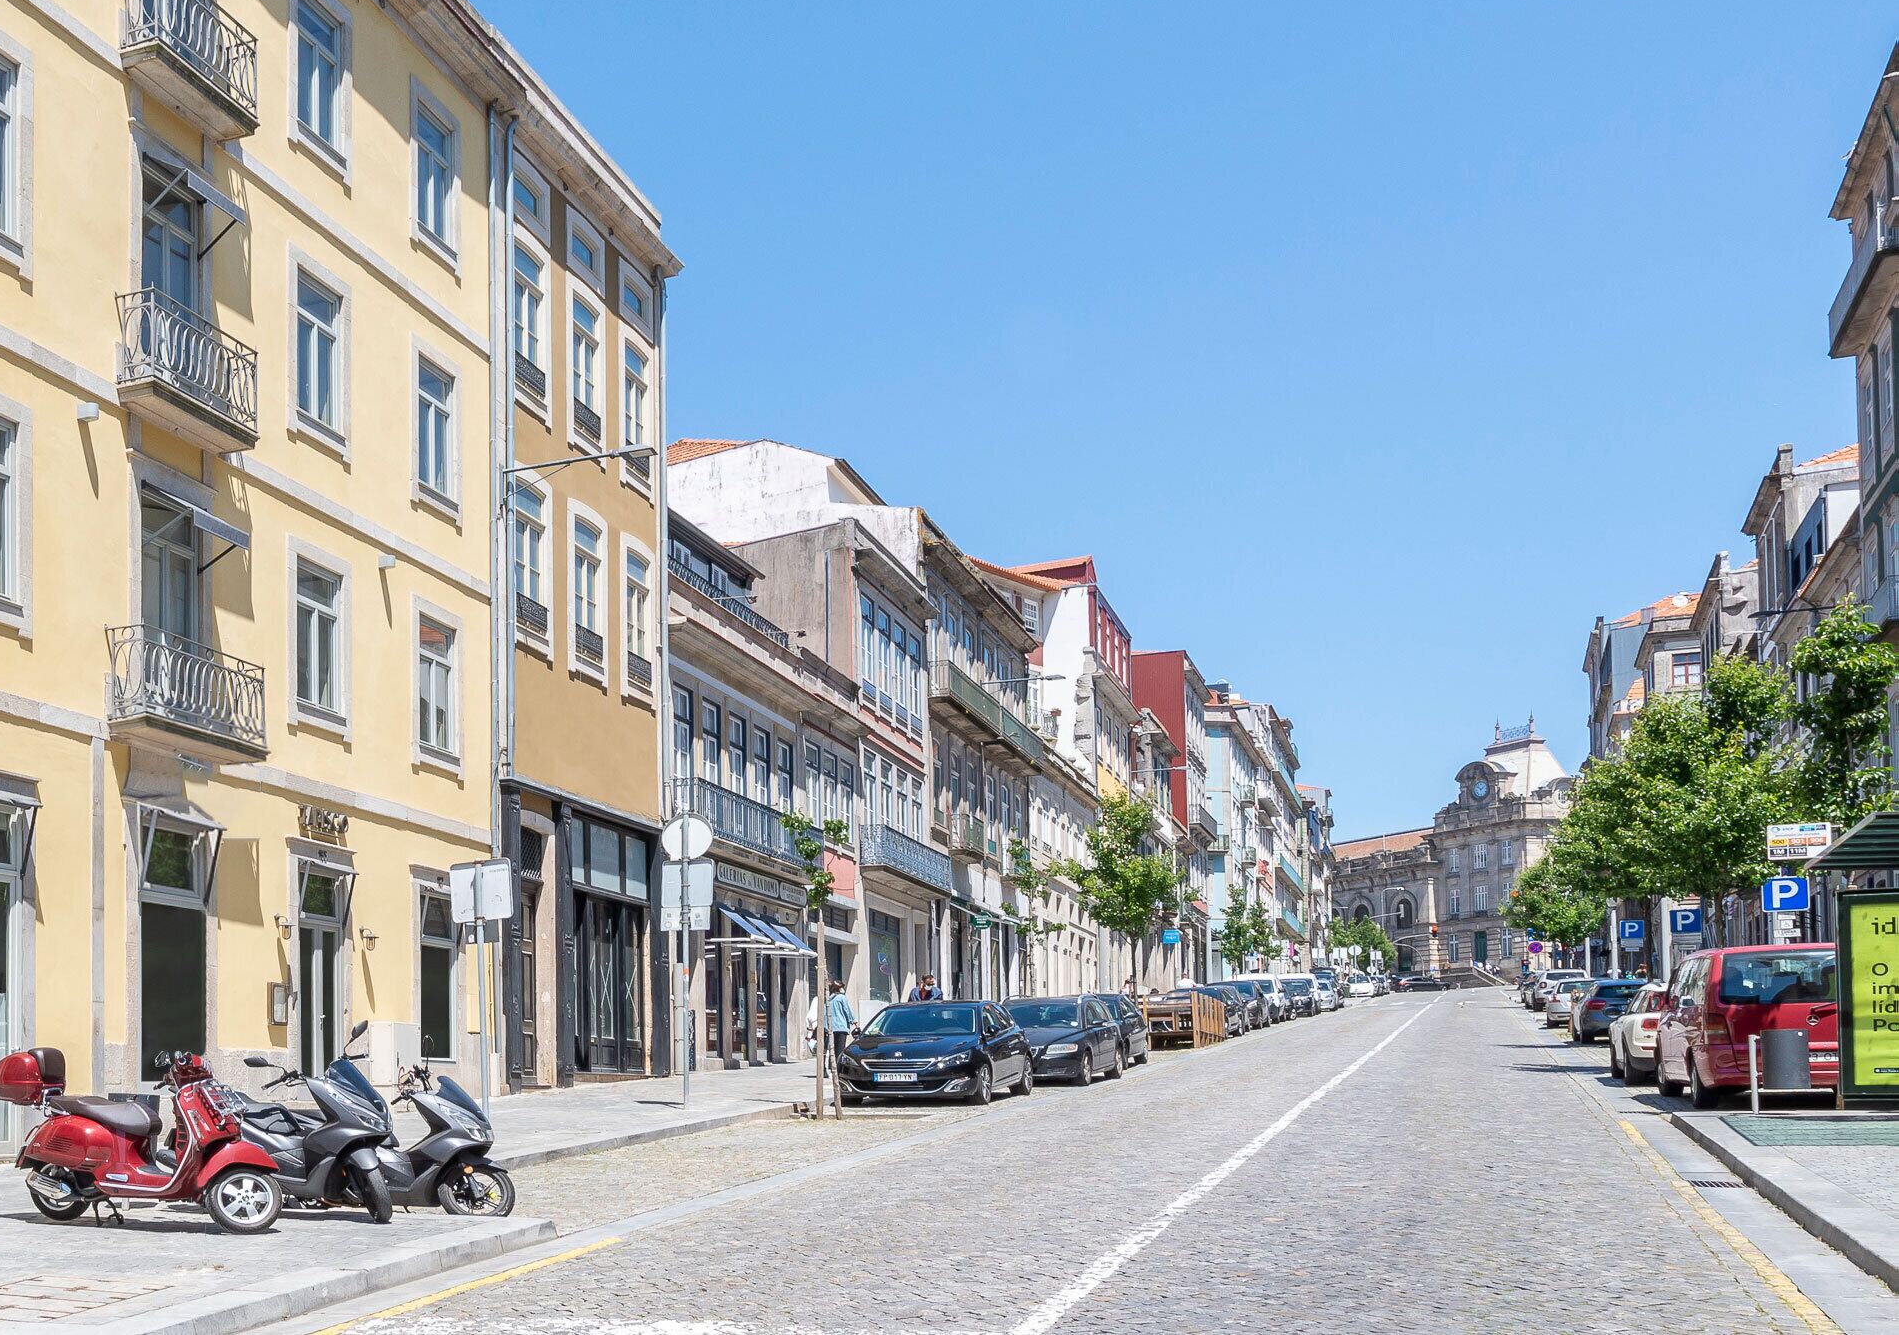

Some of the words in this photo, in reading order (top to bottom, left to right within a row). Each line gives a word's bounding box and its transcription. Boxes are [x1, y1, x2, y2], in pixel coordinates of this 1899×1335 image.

[1771, 838, 1786, 846] 500
[1790, 837, 1805, 845] 901
[1772, 848, 1785, 856] 1M
[1771, 879, 1799, 909] P
[1676, 911, 1695, 932] P
[1624, 922, 1639, 938] P
[1872, 963, 1889, 977] O
